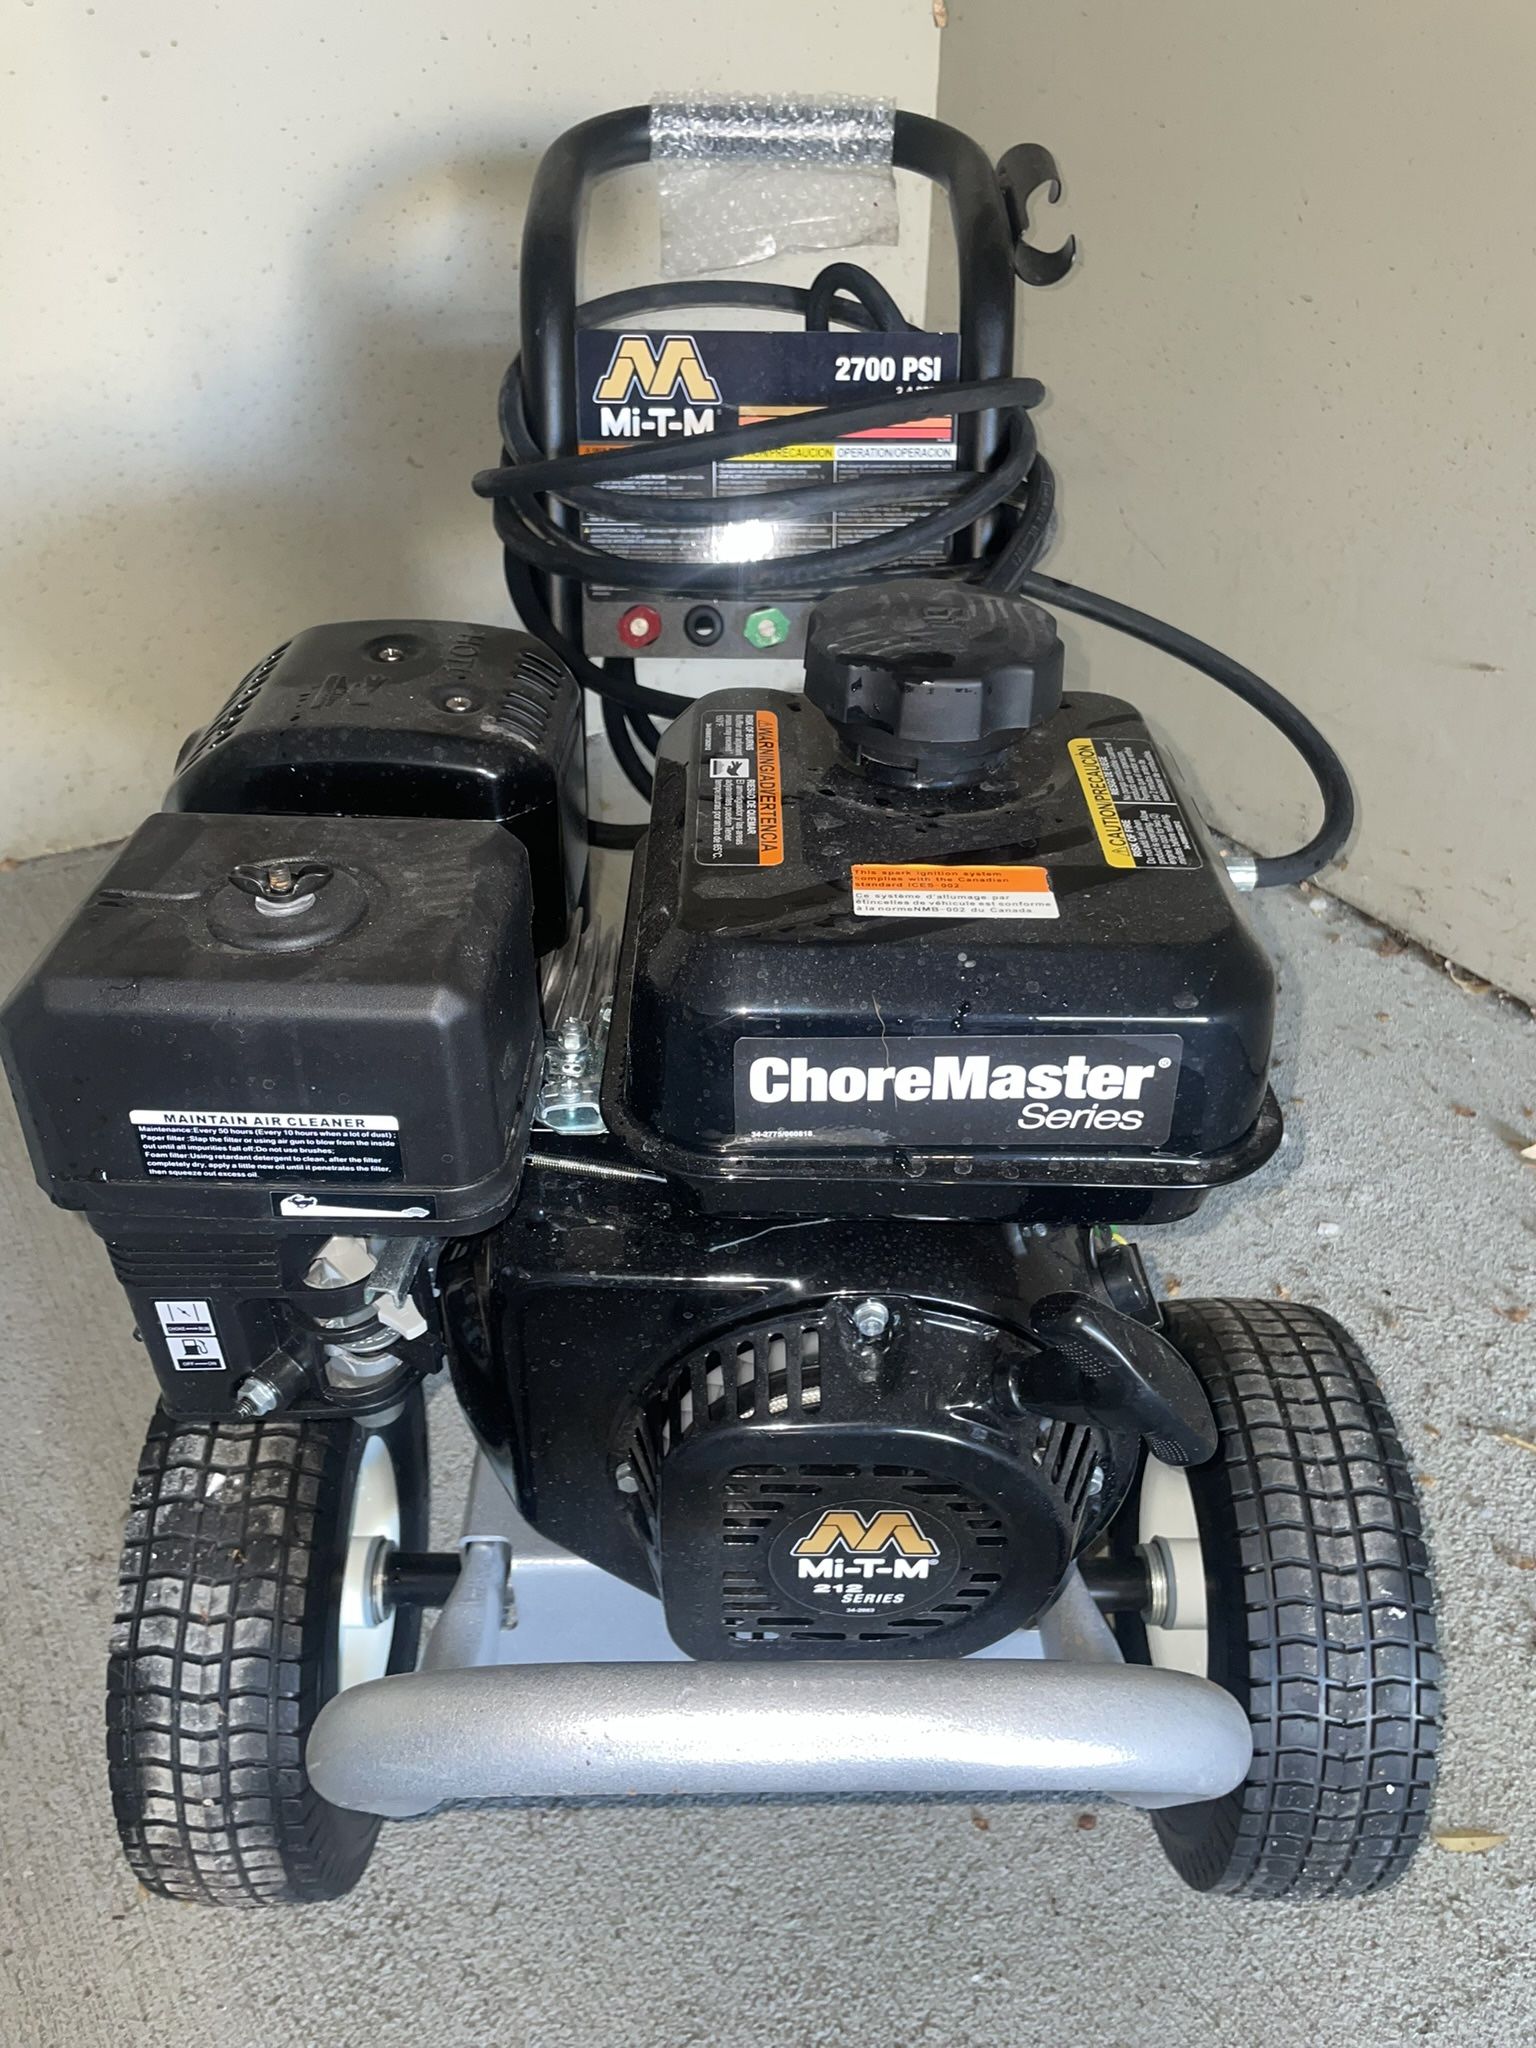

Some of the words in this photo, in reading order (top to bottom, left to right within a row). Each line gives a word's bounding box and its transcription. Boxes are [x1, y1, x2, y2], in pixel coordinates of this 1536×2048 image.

[835, 356, 896, 381] 2700
[902, 356, 941, 381] PSI
[601, 407, 714, 437] Mi-T-M
[758, 726, 778, 852] WARNING/ADVERTENCIA
[750, 1056, 1155, 1103] ChoreMaster
[163, 1114, 248, 1125] MAINTAIN
[253, 1116, 281, 1126] AIR
[286, 1117, 366, 1128] CLEANER
[1018, 1103, 1144, 1131] Series
[229, 1127, 254, 1135] hours
[294, 1129, 318, 1137] hours
[140, 1134, 166, 1142] Paper
[253, 1137, 276, 1145] using
[316, 1138, 336, 1146] blow
[187, 1144, 228, 1152] impurities
[214, 1153, 252, 1161] retardant
[252, 1154, 292, 1163] detergent
[146, 1160, 191, 1168] completely
[208, 1162, 230, 1170] apply
[168, 1169, 203, 1177] squeeze
[798, 1558, 929, 1579] Mi-T-M
[812, 1583, 864, 1593] 212
[840, 1593, 906, 1604] SERIES
